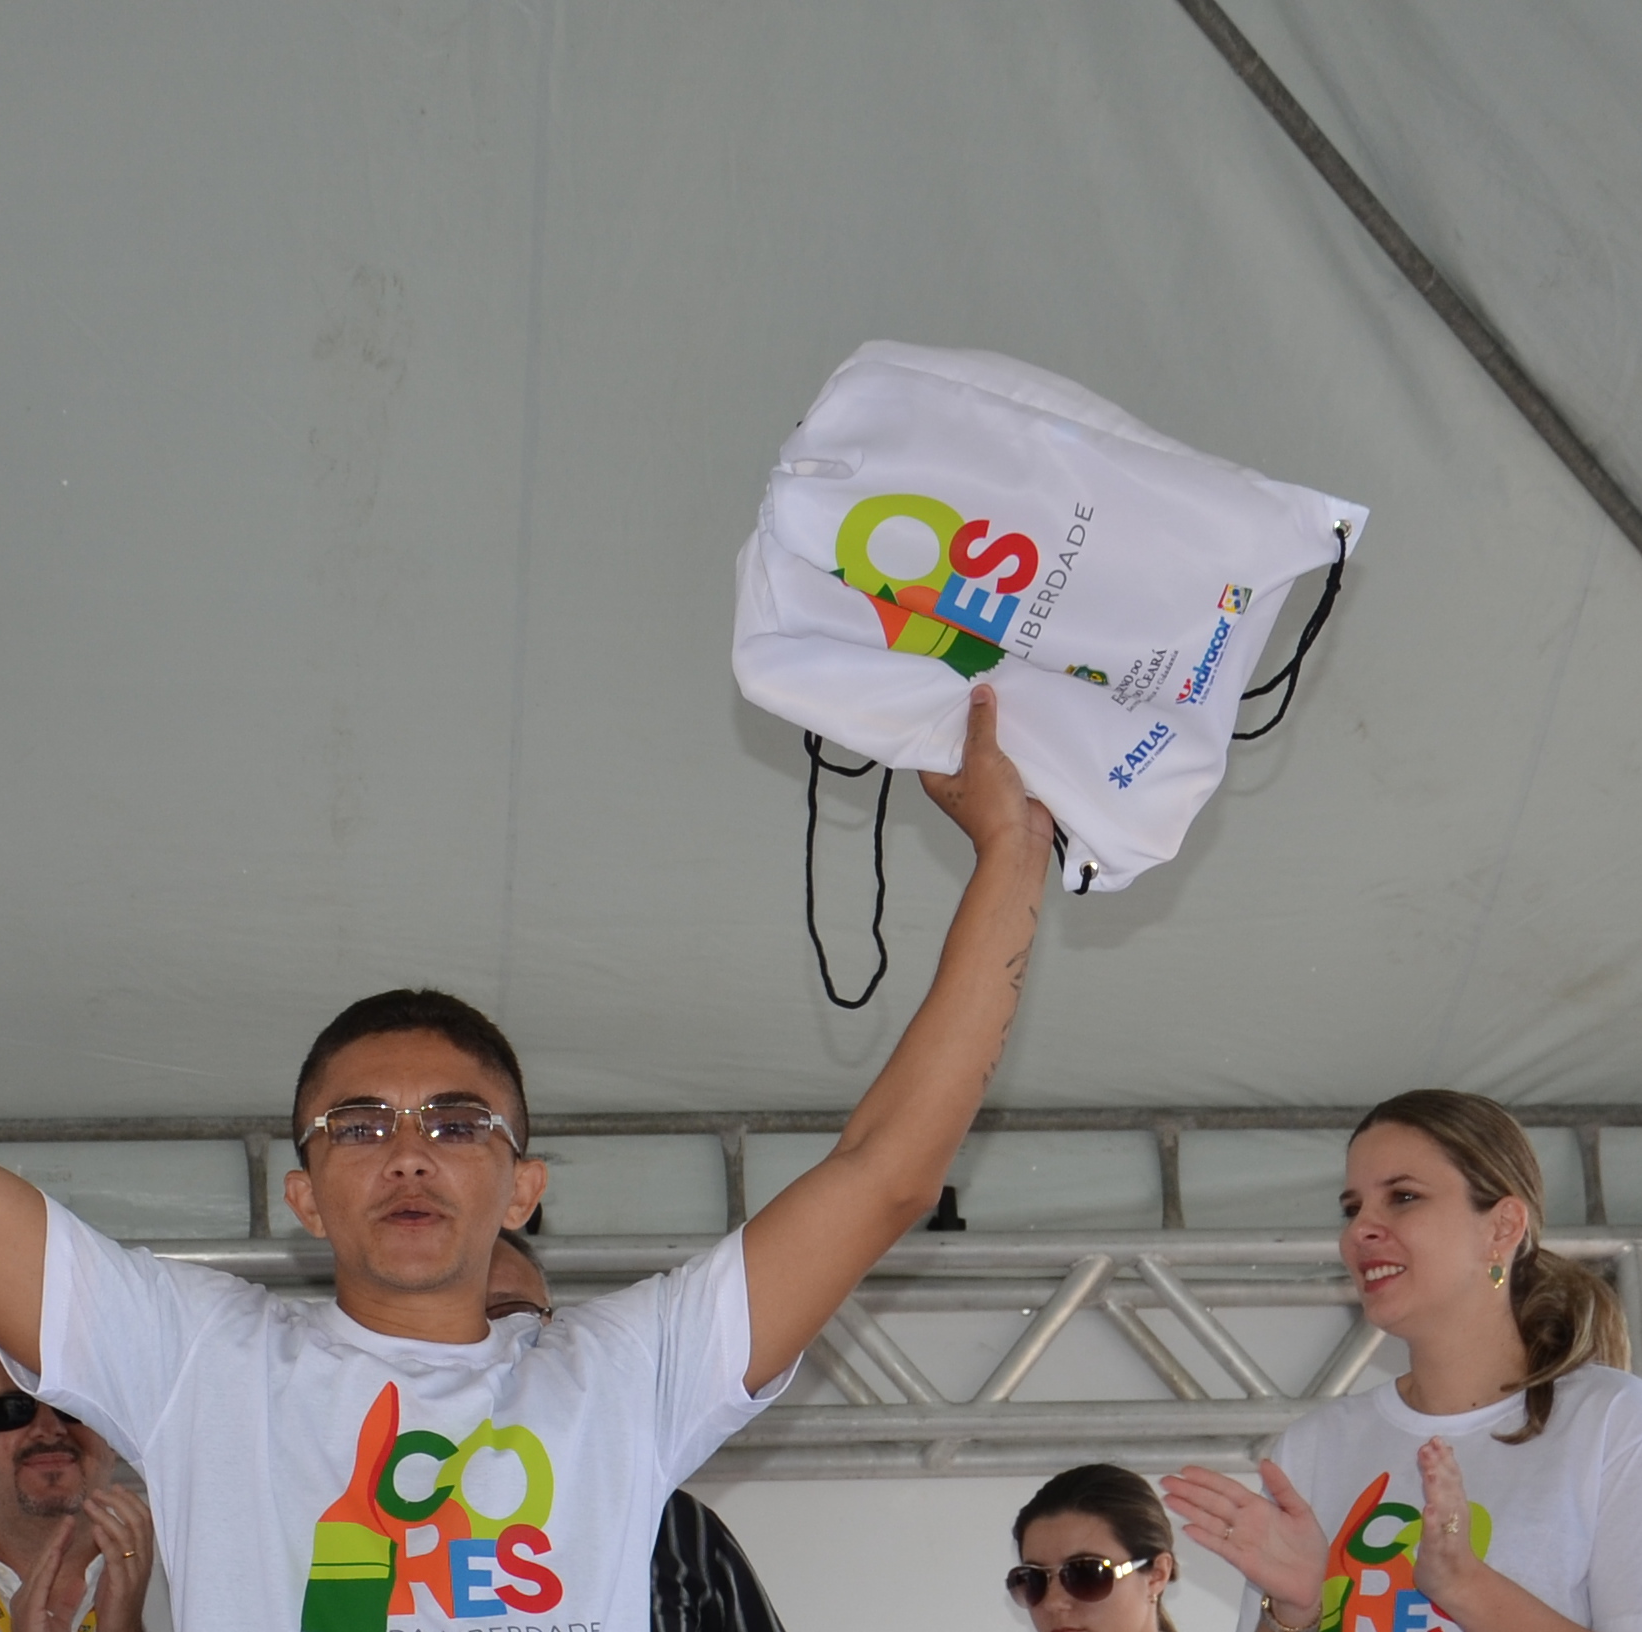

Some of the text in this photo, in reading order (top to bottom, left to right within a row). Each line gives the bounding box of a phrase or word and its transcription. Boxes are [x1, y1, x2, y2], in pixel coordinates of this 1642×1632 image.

[1134, 649, 1168, 689] CEARÁ
[1175, 616, 1230, 704] Hidracor
[1124, 721, 1169, 770] ATLAS
